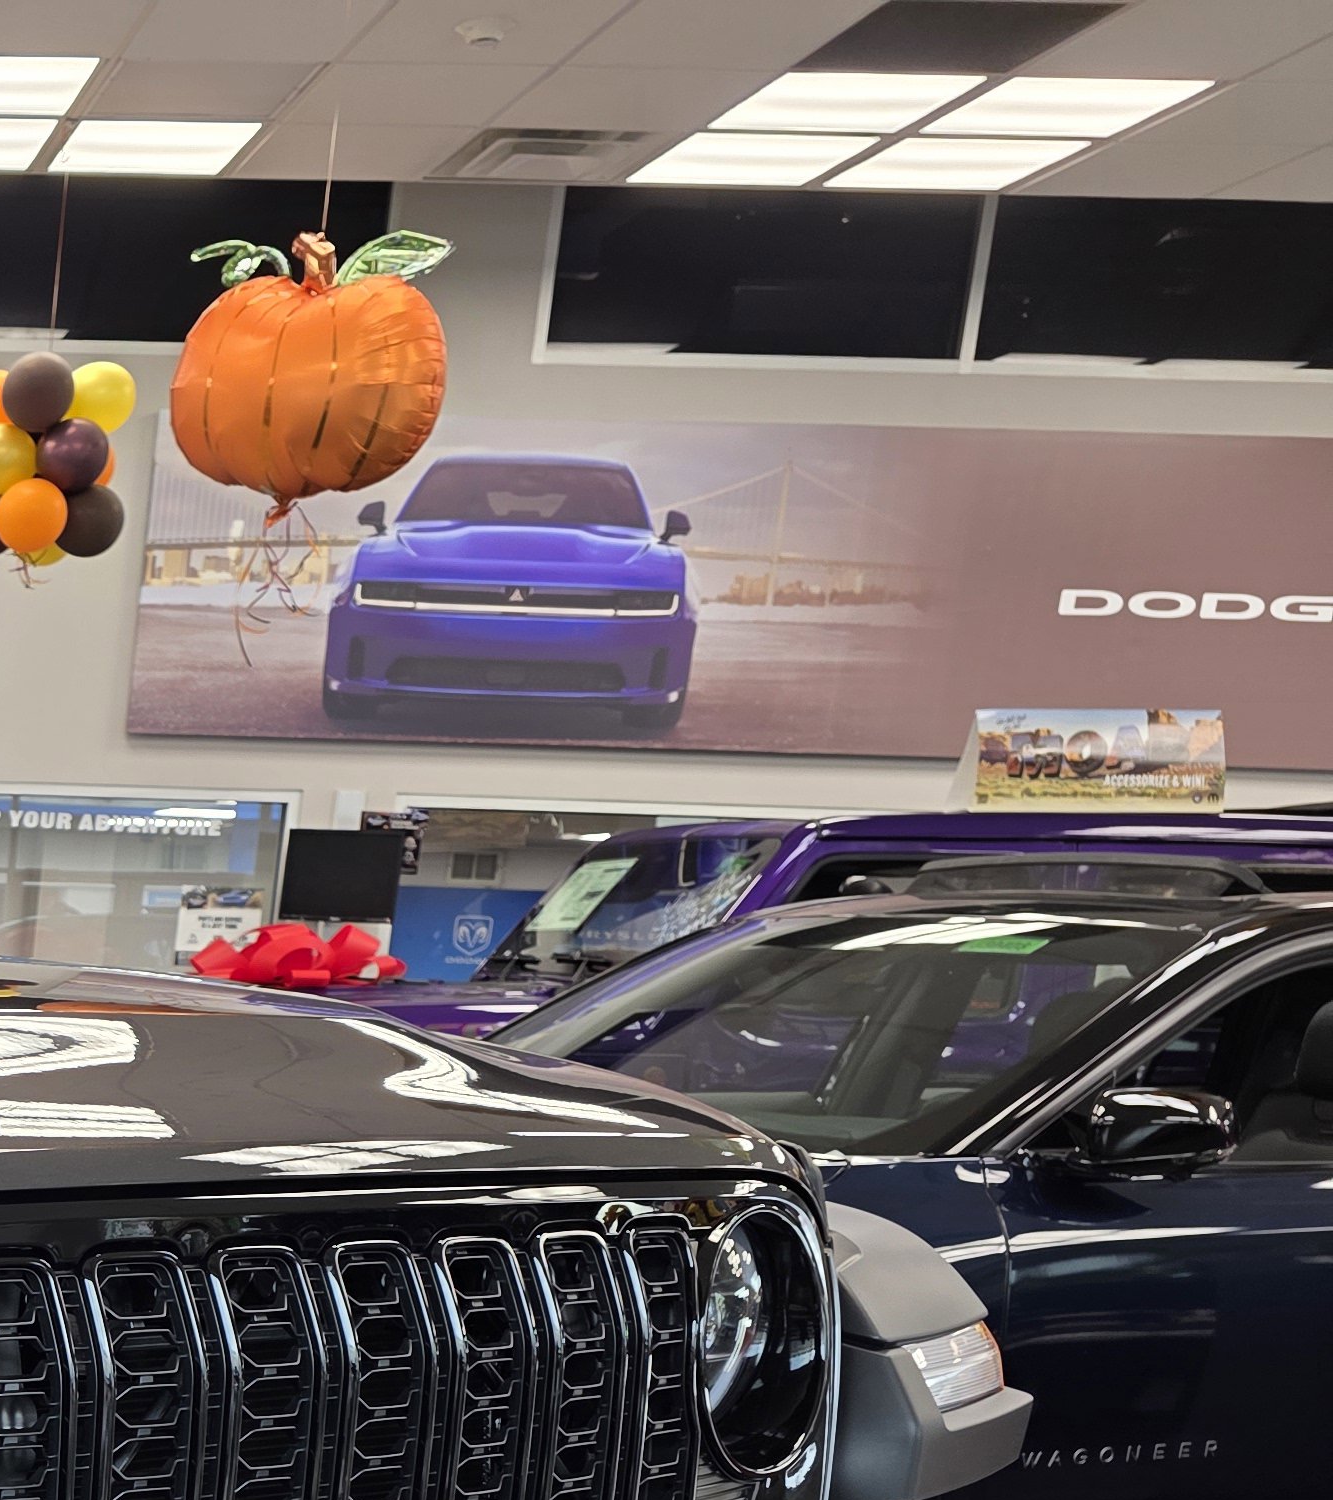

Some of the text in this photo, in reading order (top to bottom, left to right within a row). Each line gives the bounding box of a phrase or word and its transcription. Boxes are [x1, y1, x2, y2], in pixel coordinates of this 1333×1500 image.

[1103, 774, 1170, 788] ACCESSORIZE
[9, 809, 72, 830] YOUR
[1022, 1439, 1218, 1467] WAGONEER
